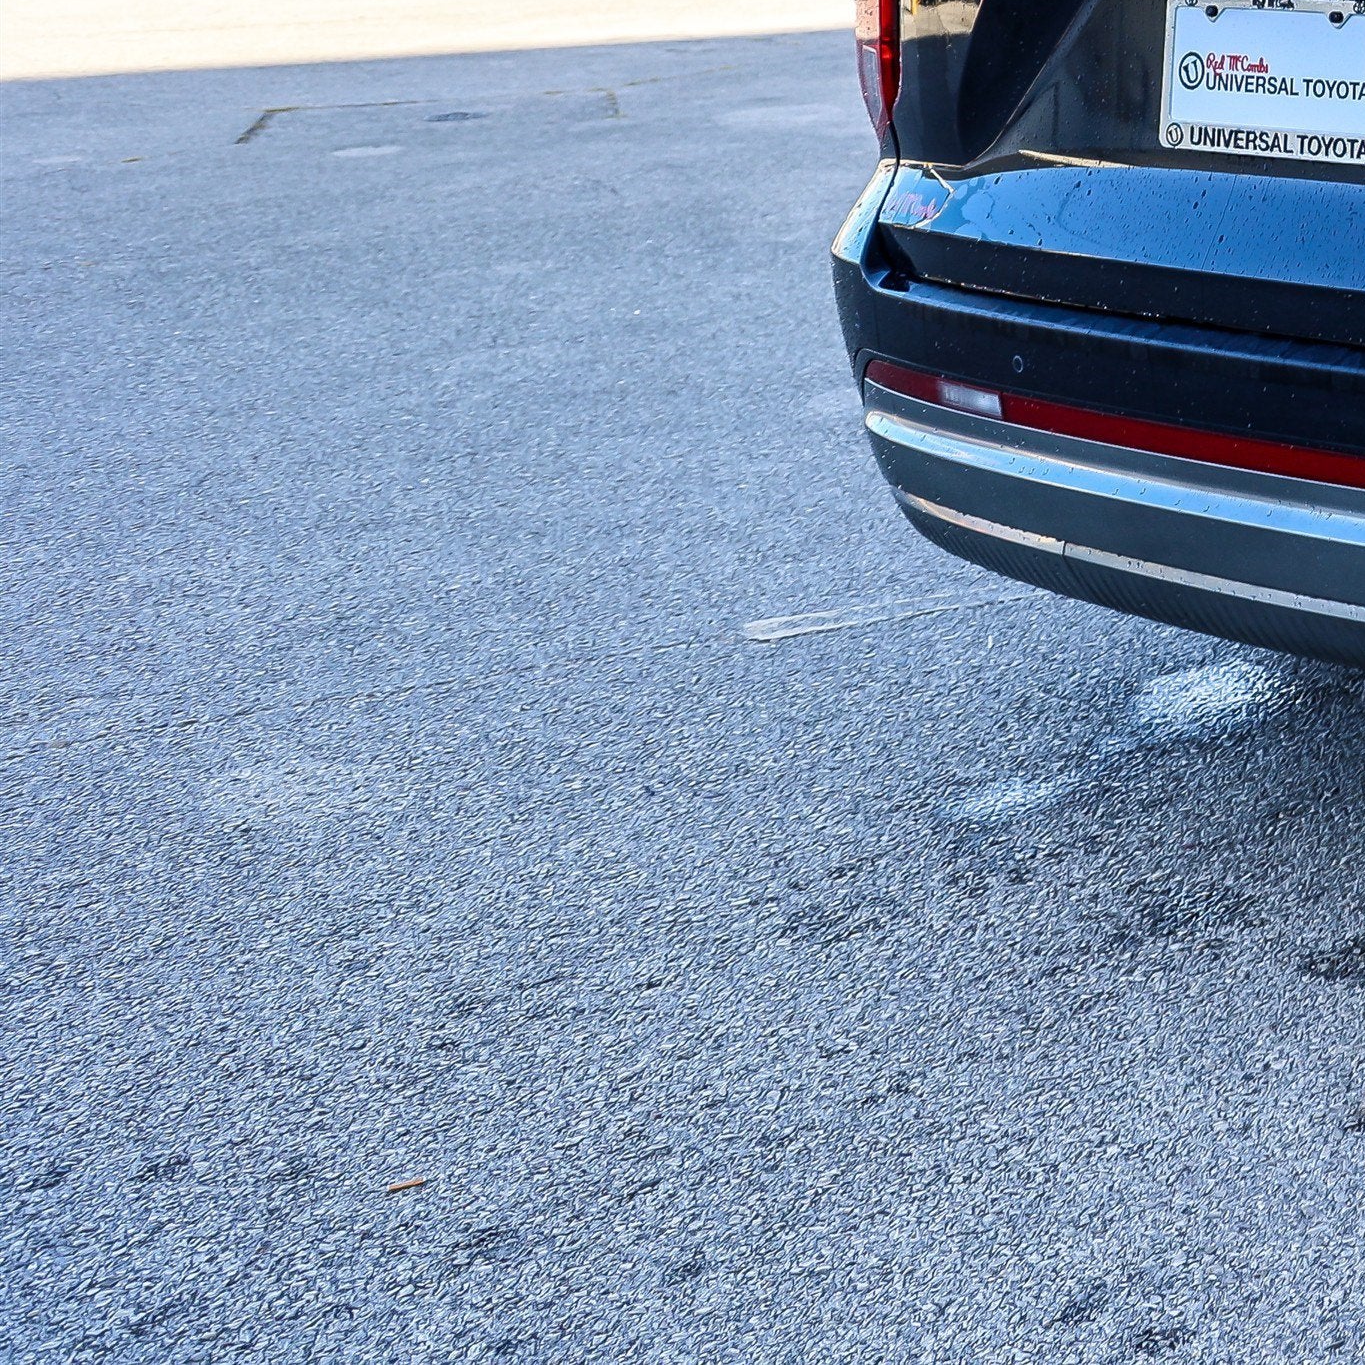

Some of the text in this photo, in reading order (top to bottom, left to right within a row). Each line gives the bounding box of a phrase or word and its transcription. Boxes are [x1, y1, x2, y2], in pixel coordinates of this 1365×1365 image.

[1206, 52, 1269, 76] Red McCombs
[1206, 72, 1299, 97] UNIVERSAL
[1190, 125, 1294, 154] UNIVERSAL
